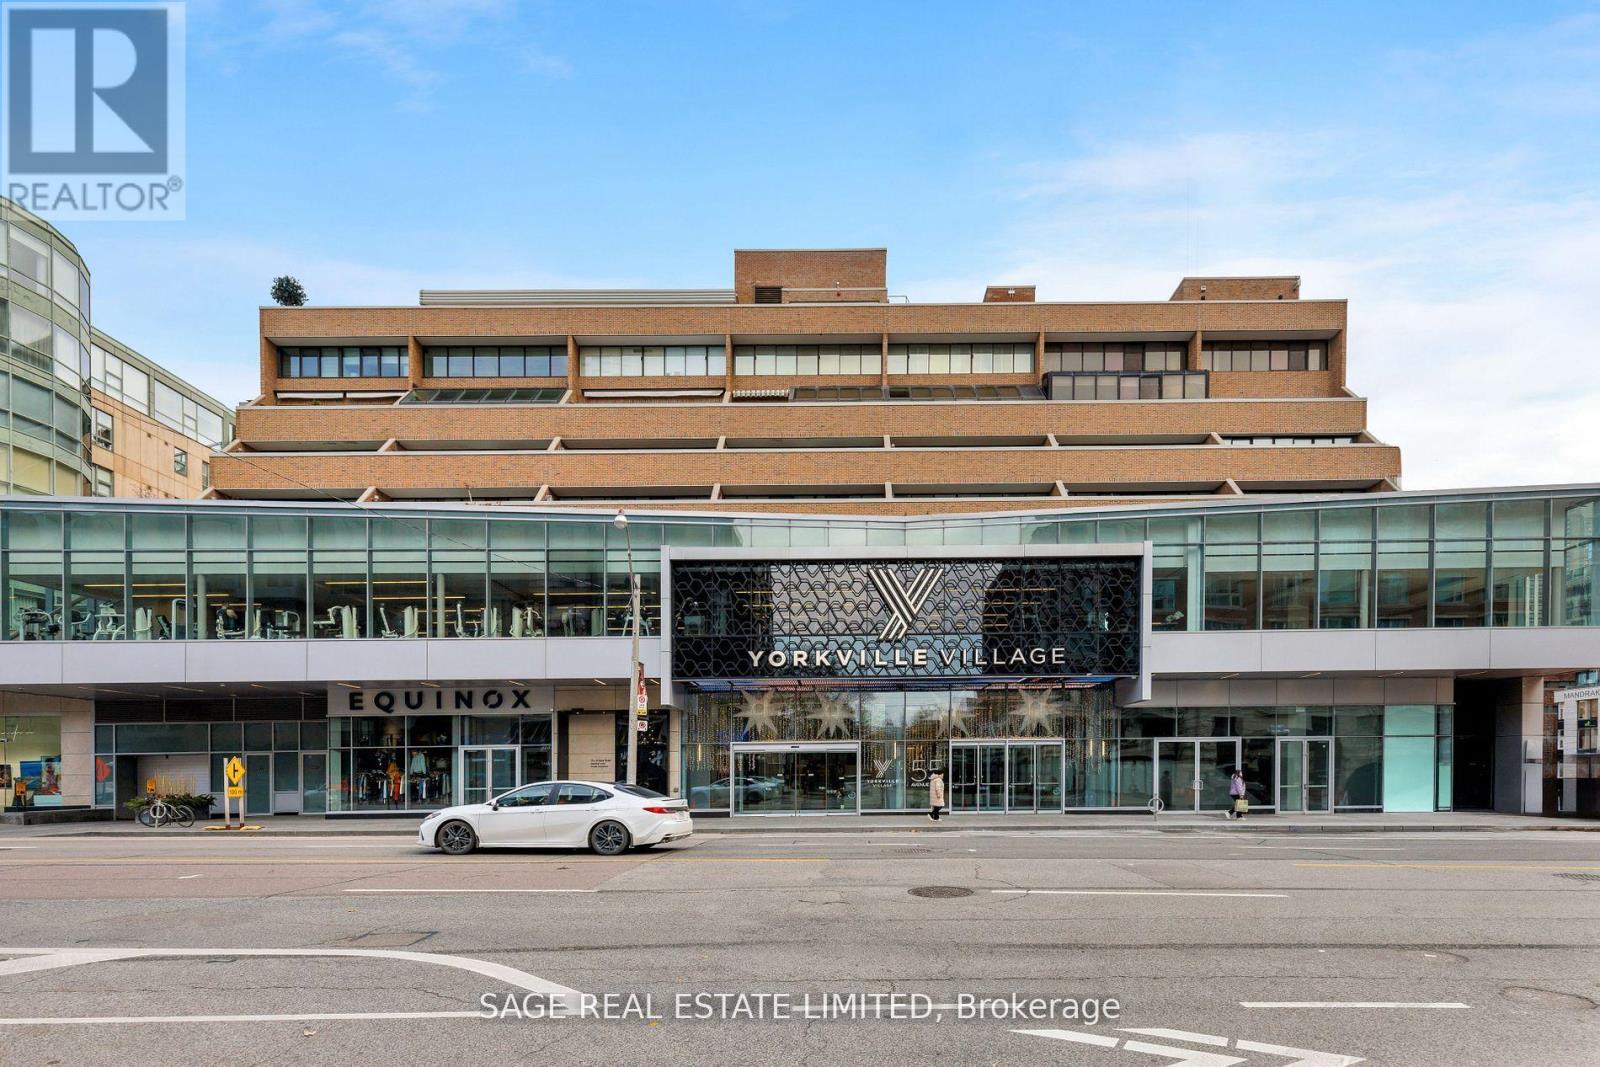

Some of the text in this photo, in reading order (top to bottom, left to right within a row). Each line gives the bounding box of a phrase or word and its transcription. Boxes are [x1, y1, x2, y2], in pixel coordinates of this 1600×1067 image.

[747, 648, 1066, 668] YORKVILLE VILLAGE
[349, 690, 530, 713] EQUINOX
